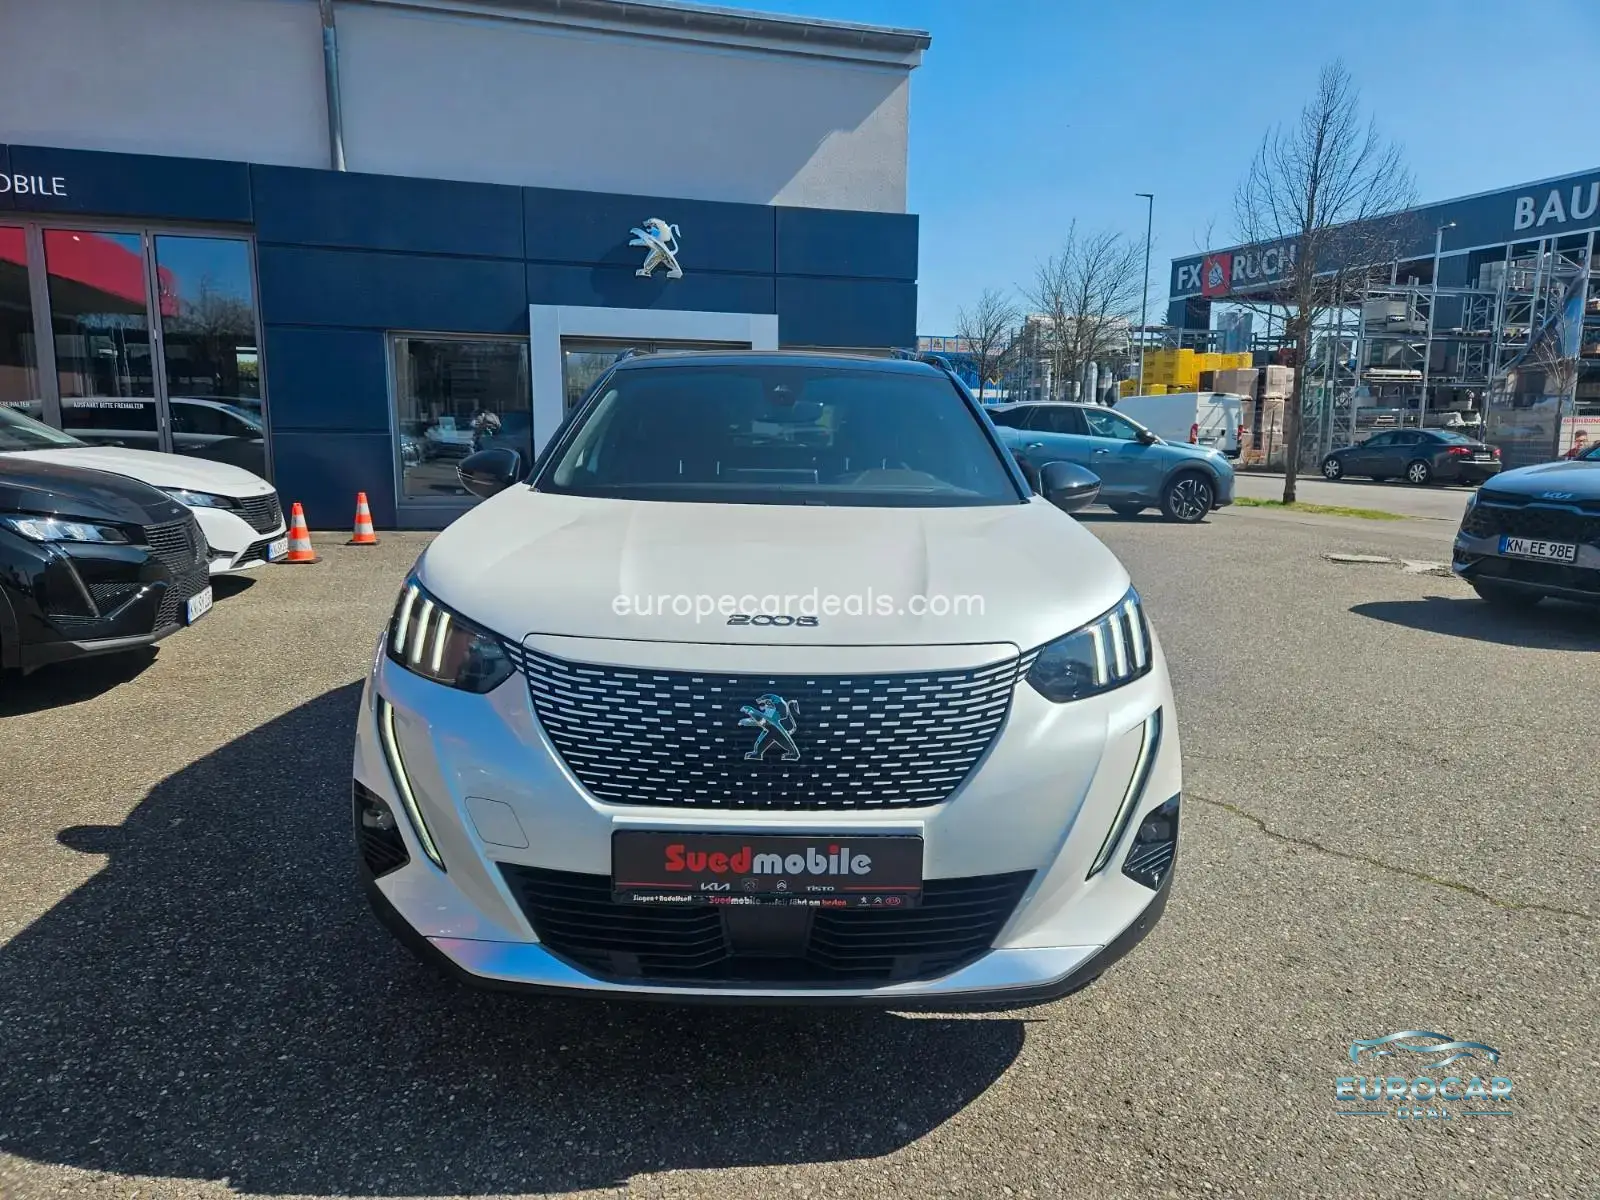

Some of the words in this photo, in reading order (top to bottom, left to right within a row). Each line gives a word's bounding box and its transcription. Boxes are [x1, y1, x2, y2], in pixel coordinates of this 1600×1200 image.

[1514, 182, 1600, 231] BAU
[1177, 263, 1202, 290] FX
[1232, 245, 1297, 281] RUCH
[114, 402, 144, 410] FREIHALTEN
[1506, 539, 1523, 552] KN
[1530, 541, 1547, 555] EE
[1549, 544, 1574, 559] 98E
[727, 614, 819, 627] 2008
[665, 844, 872, 875] Suedmobile
[700, 882, 731, 891] KIA
